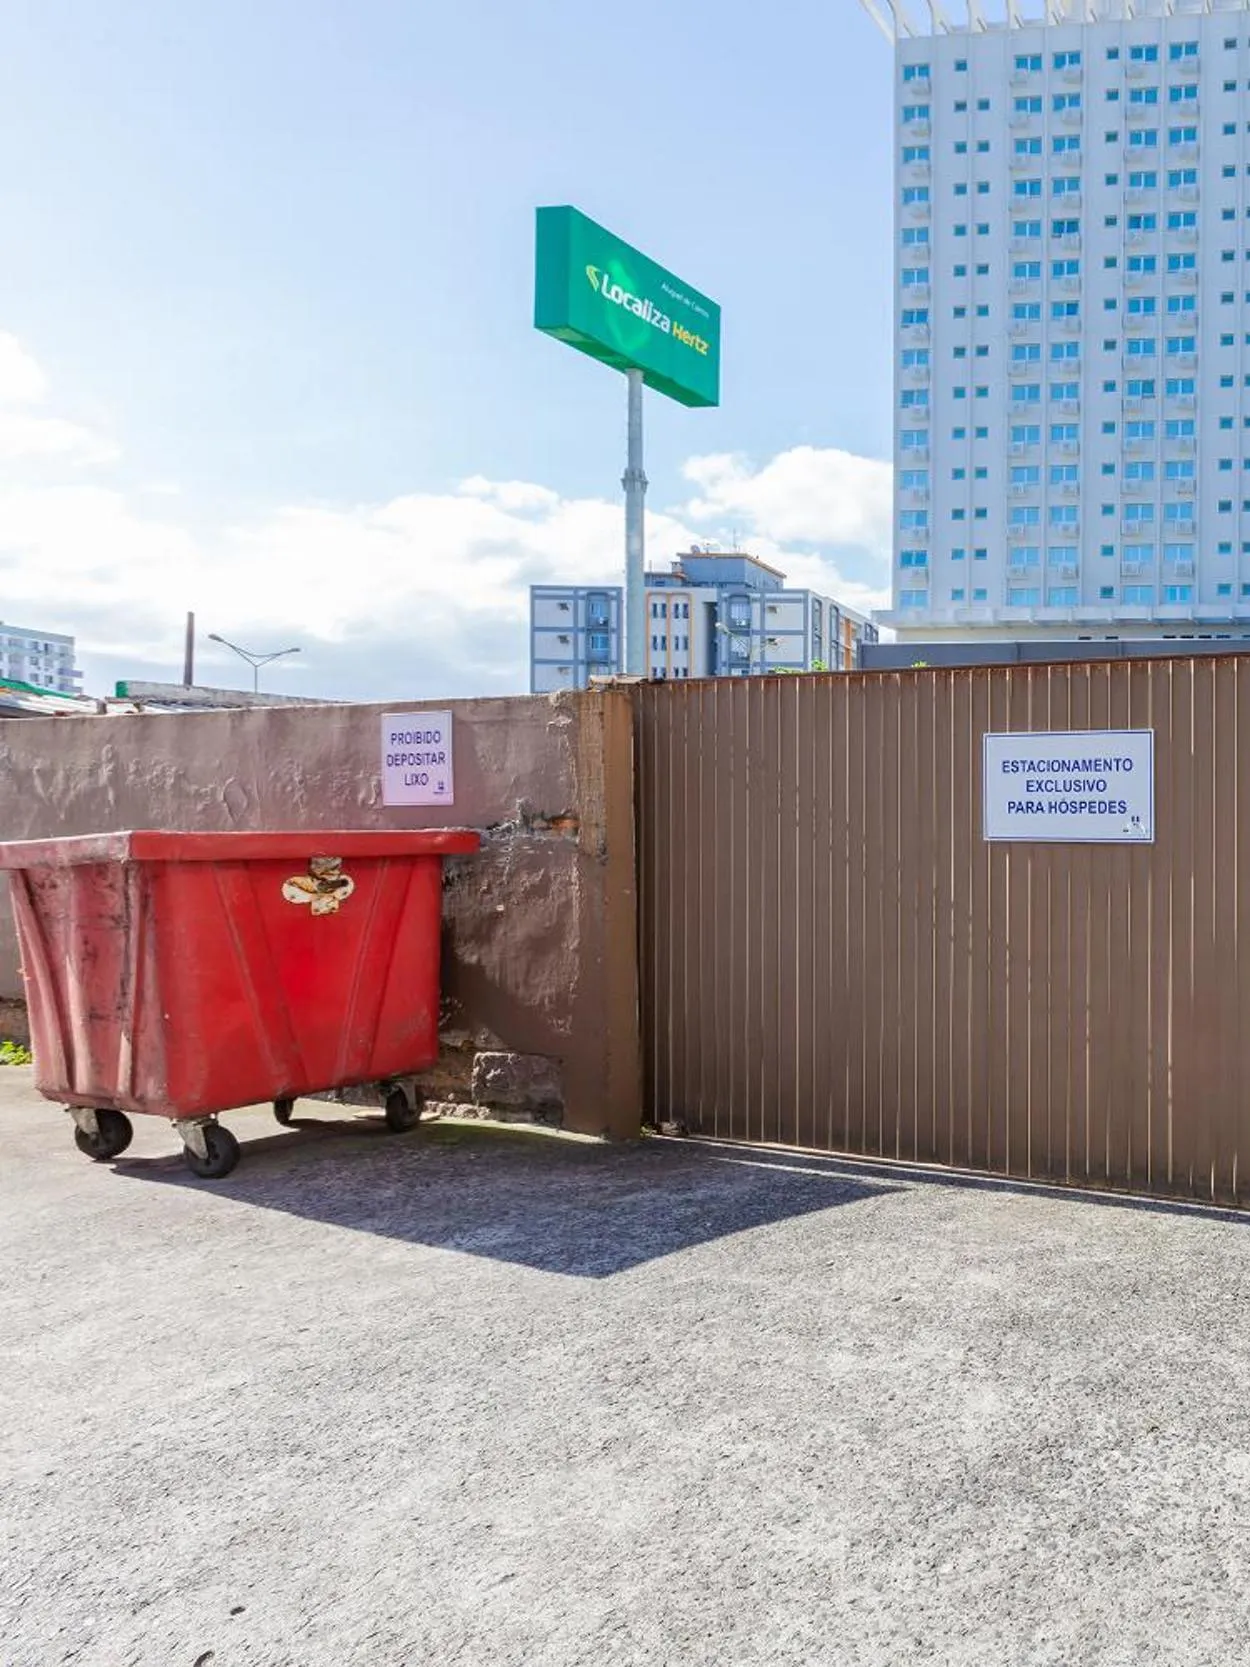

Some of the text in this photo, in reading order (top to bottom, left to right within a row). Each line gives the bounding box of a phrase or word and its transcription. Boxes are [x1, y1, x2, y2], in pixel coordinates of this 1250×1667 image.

[601, 273, 709, 356] Localiza Hertz
[390, 731, 441, 746] PROIBIDO
[386, 751, 446, 767] DEPOSITAR
[1002, 758, 1134, 774] ESTACIONAMENTO
[404, 772, 429, 786] LIXO
[1025, 779, 1108, 793] EXCLUSIVO
[1007, 800, 1045, 815] PARA
